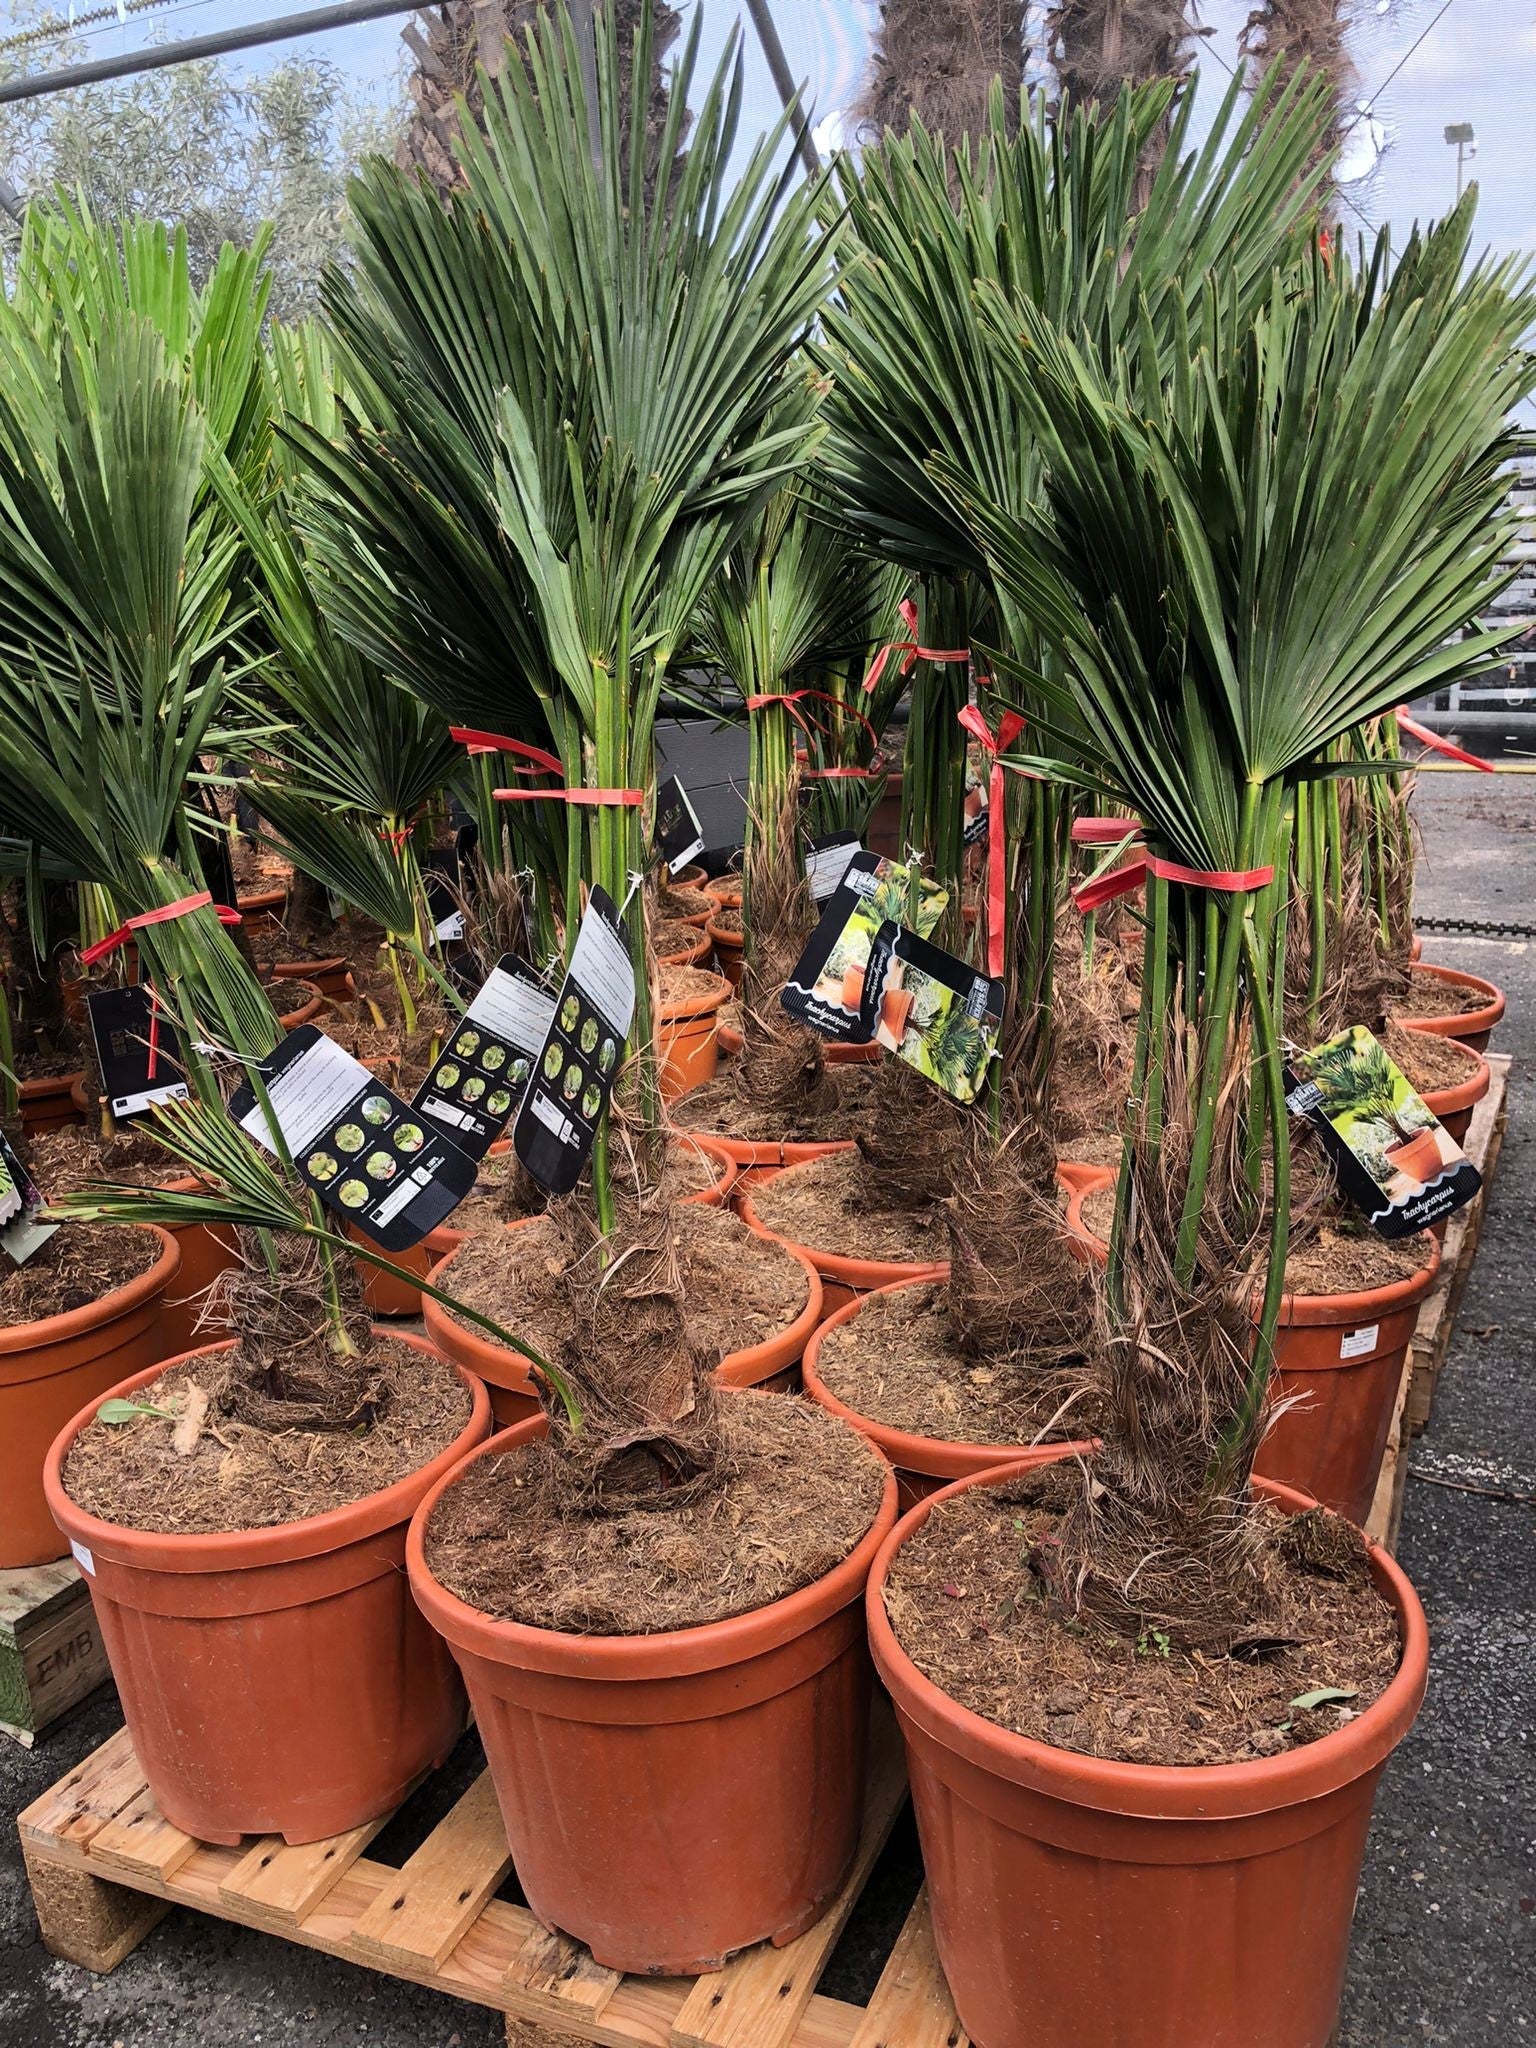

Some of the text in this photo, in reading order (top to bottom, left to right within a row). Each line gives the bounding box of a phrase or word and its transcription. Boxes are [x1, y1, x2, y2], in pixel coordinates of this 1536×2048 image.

[804, 1001, 852, 1029] Trachycarpus
[1401, 1186, 1455, 1221] Trachycarpus
[36, 1630, 93, 1687] EMB
